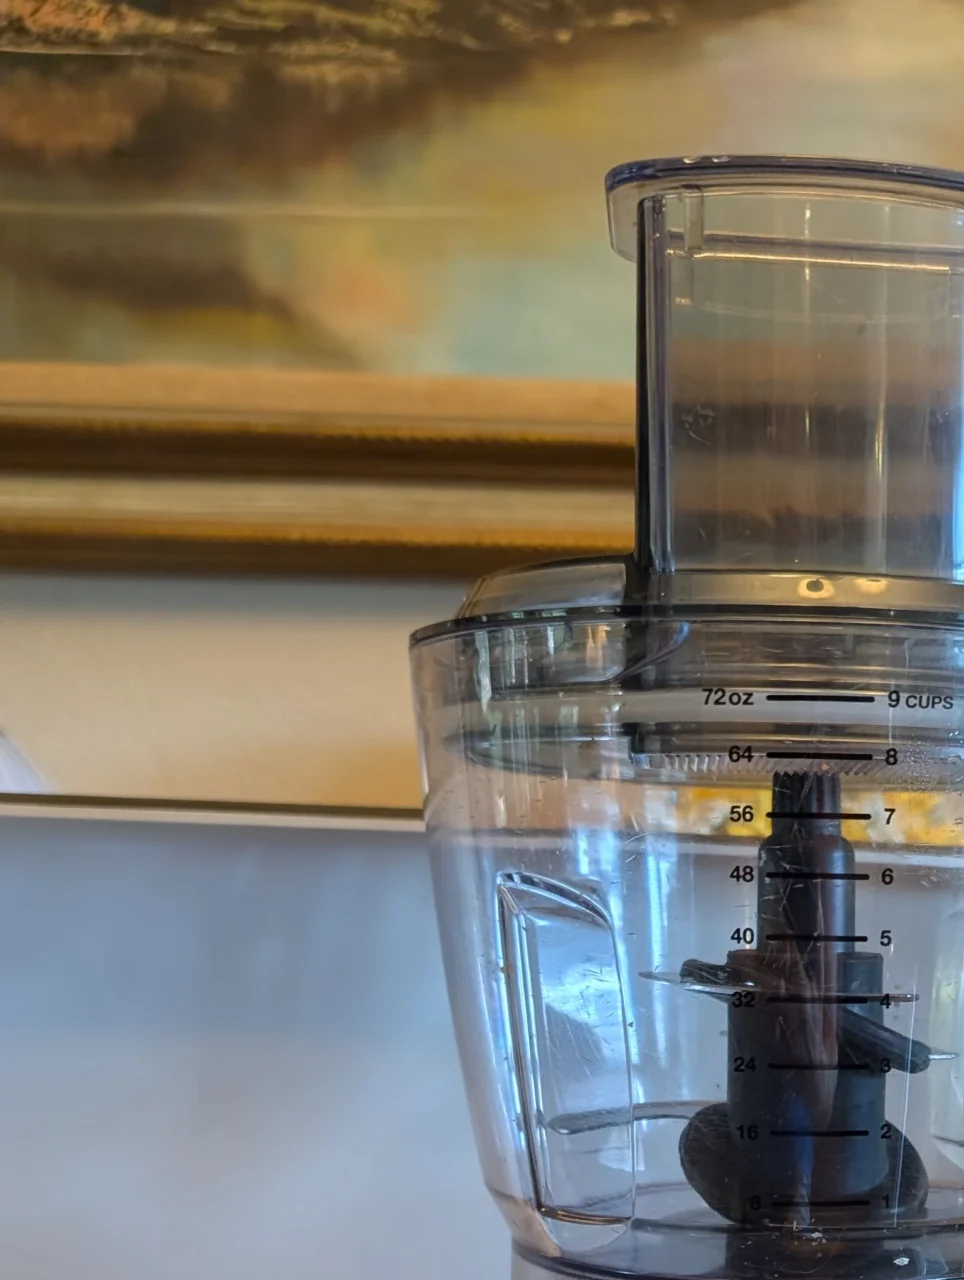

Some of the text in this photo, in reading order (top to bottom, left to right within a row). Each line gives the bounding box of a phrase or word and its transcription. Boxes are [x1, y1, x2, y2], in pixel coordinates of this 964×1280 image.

[702, 688, 954, 710] 72oz 9 CUPS
[728, 746, 898, 766] 64 8
[729, 806, 896, 825] 56 7
[729, 866, 894, 885] 48 6
[730, 928, 892, 947] 40 5
[731, 992, 891, 1010] 32 4
[733, 1057, 892, 1073] 24 3
[880, 1124, 892, 1140] 2
